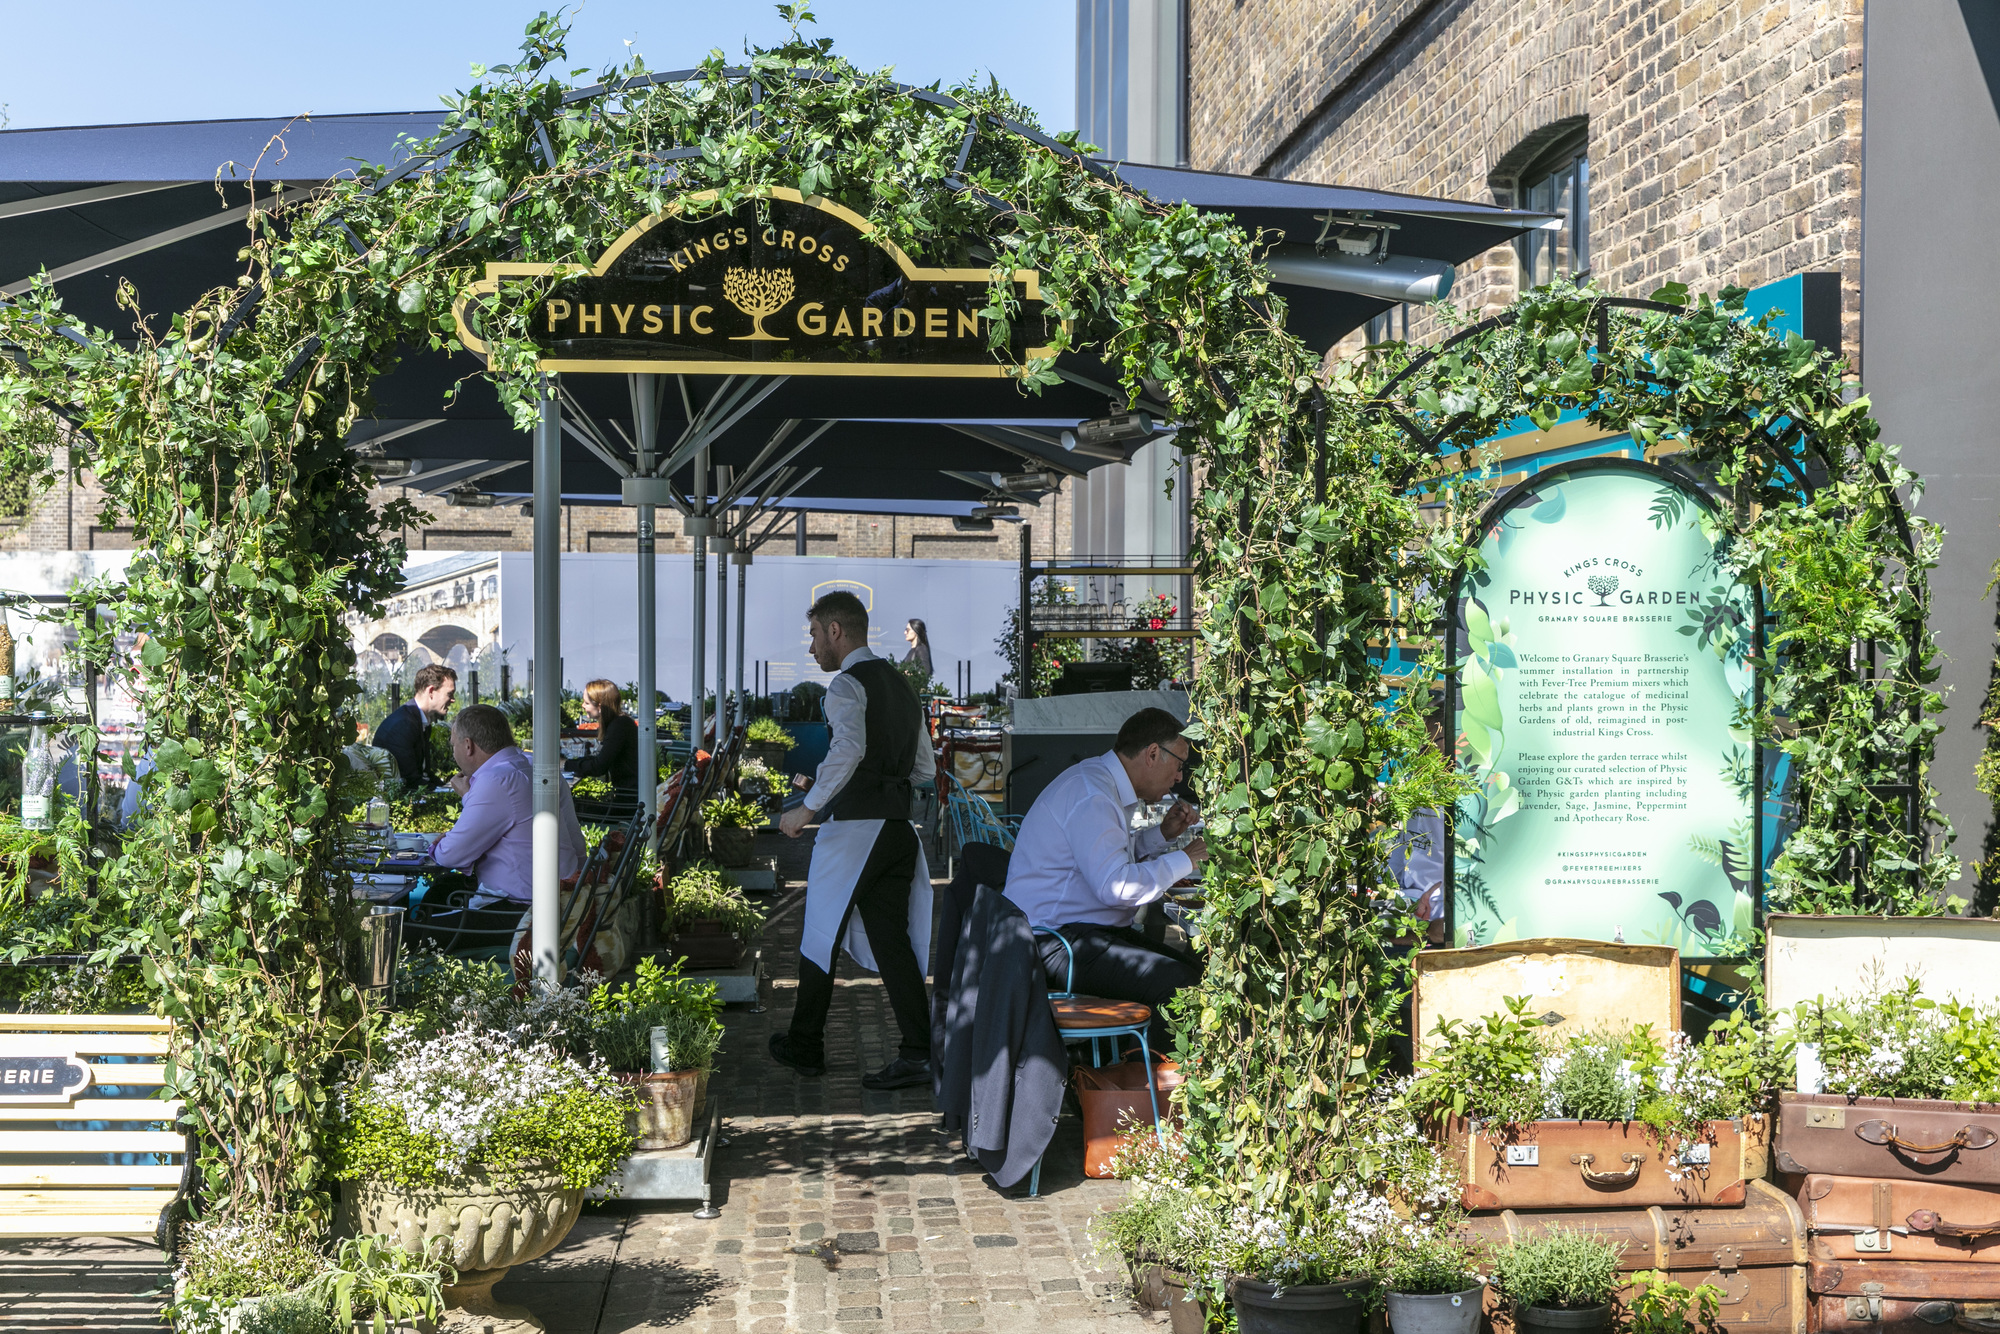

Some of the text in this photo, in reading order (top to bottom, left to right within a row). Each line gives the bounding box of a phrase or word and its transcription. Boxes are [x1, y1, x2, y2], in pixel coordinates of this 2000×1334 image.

[668, 227, 850, 273] KING'S CROSS
[548, 299, 979, 338] PHYSIC GARDEN
[1563, 557, 1643, 578] KING'S CROSS
[1509, 589, 1700, 605] PHYSIC GARDEN
[1538, 615, 1673, 623] GRANARY SQUARE BRASSERIE
[1520, 654, 1689, 664] Welcome to Granary Square Brasserie's
[1562, 666, 1613, 675] installation
[1621, 666, 1629, 675] in
[1638, 667, 1689, 677] partnership
[1519, 679, 1538, 687] with
[1542, 679, 1586, 687] Fever-Tree
[1591, 679, 1628, 687] Premium
[1663, 678, 1688, 686] which
[1519, 691, 1688, 701] celebrate the catalogue of medicinal
[1519, 704, 1542, 712] herbs
[1567, 704, 1593, 714] plants
[1597, 706, 1624, 714] grown
[1643, 703, 1656, 711] the
[1661, 703, 1688, 713] Physic
[1519, 716, 1555, 724] Gardens
[1561, 716, 1571, 724] of
[1576, 716, 1591, 724] old,
[1598, 716, 1646, 726] reimagined
[1666, 717, 1688, 726] post-
[1553, 728, 1653, 738] industrial Kings Cross.
[1548, 753, 1578, 763] explore
[1598, 753, 1626, 763] garden
[1662, 752, 1687, 760] whilst
[1518, 765, 1555, 776] enjoying
[1574, 765, 1605, 773] curated
[1649, 764, 1658, 772] of
[1660, 764, 1687, 774] Physic
[1518, 777, 1550, 786] Garden
[1556, 777, 1583, 785] G&Ts
[1588, 777, 1613, 785] which
[1637, 777, 1672, 787] inspired
[1677, 777, 1687, 787] by
[1518, 789, 1687, 799] the Physic garden planting including
[1518, 801, 1686, 812] Lavender, Sage, Jasmine, Peppermint
[1573, 814, 1623, 824] Apothecary
[1562, 864, 1642, 872] @FEVERTREEMIXERS
[1544, 878, 1659, 886] @GRANARYSQUAREBRASSERIE
[0, 1069, 55, 1084] ERIE
